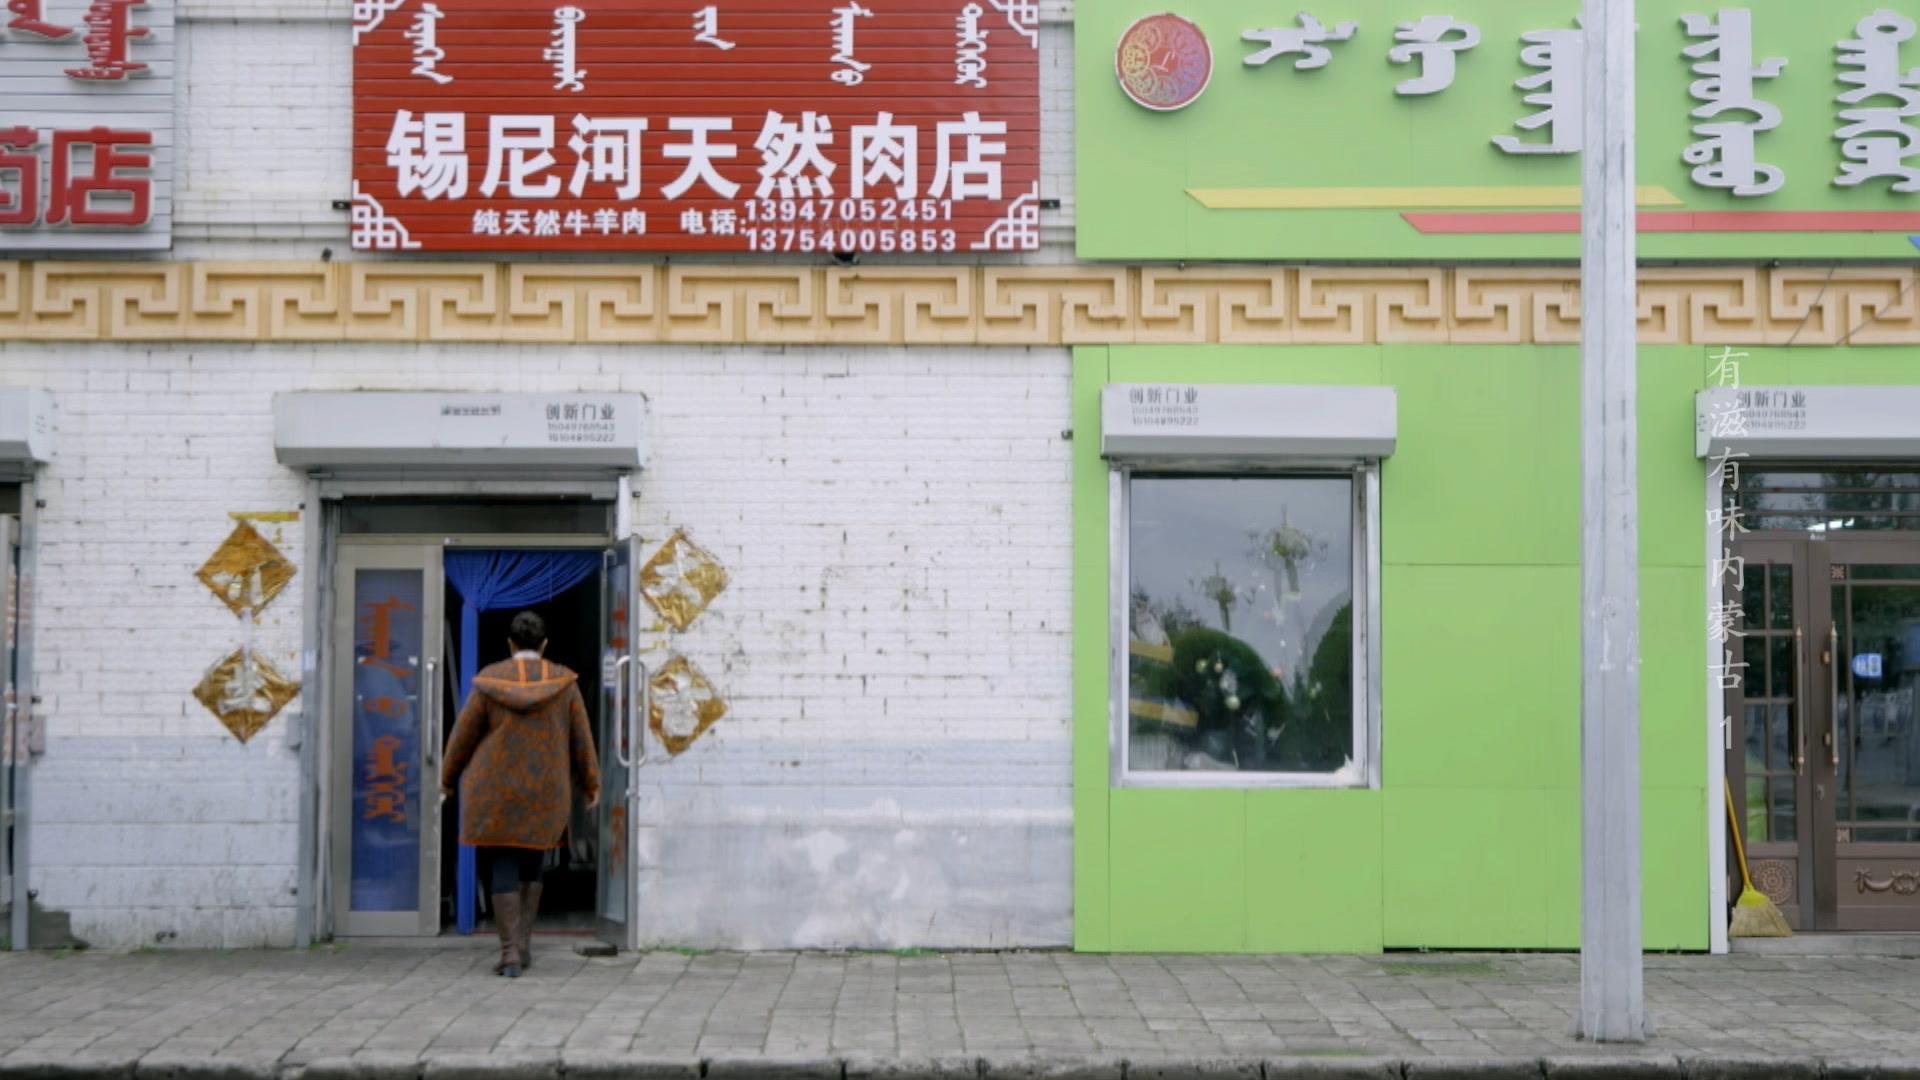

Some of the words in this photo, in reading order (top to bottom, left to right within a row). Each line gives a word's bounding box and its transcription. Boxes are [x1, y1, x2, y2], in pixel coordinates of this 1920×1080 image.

[386, 110, 1008, 201] 锡尼河天然肉店
[745, 198, 952, 221] 13947052451
[472, 209, 647, 235] 纯天然牛羊肉
[745, 229, 956, 251] 13754005853
[1129, 386, 1198, 404] 创新门业
[545, 402, 616, 420] 创新门业
